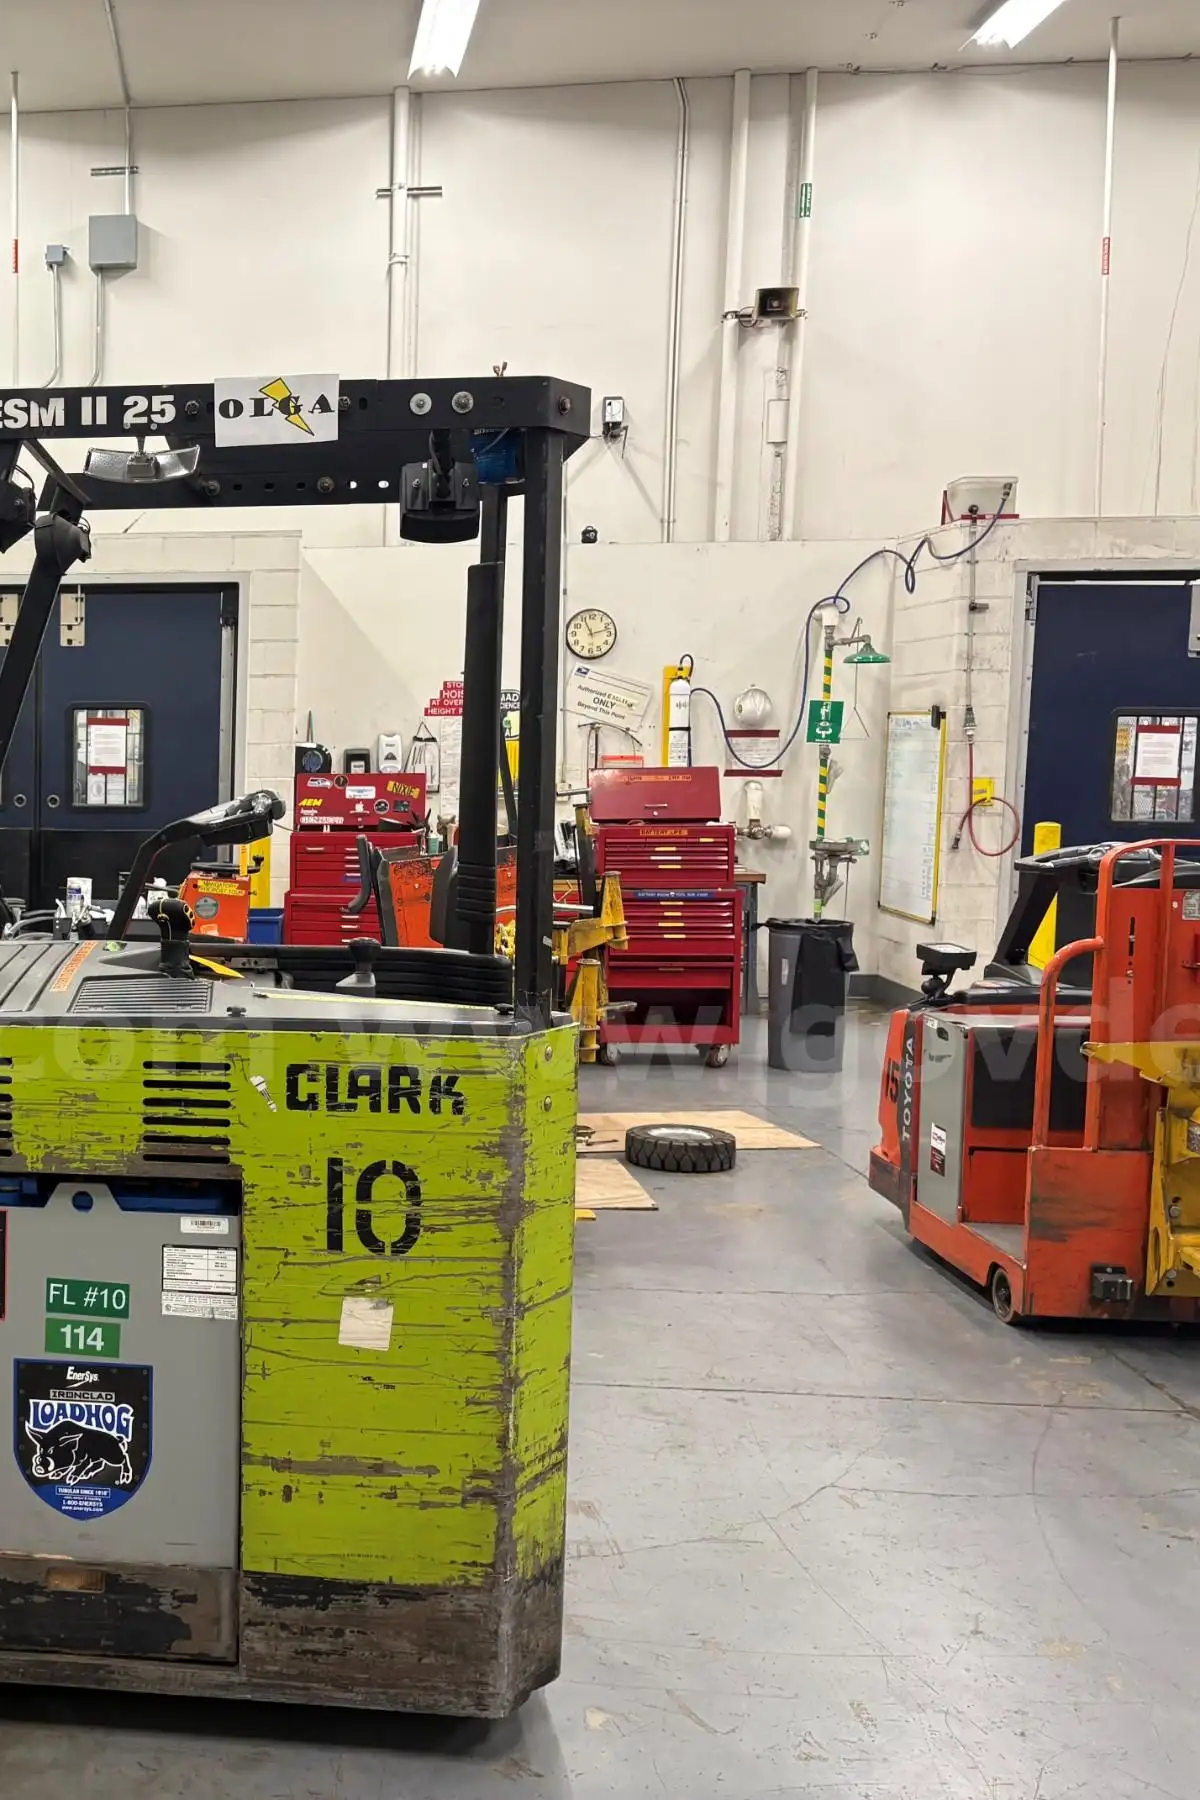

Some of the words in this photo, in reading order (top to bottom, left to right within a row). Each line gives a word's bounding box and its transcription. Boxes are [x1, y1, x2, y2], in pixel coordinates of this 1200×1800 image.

[81, 396, 107, 426] II
[123, 394, 176, 424] 25
[218, 393, 335, 419] OLGA
[577, 701, 598, 712] Beyond
[593, 697, 616, 709] ONLY
[286, 1064, 465, 1115] CLARK
[902, 1036, 914, 1142] TOYOTA
[326, 1157, 421, 1256] 10
[49, 1283, 76, 1305] FL
[84, 1288, 126, 1309] #10
[60, 1324, 105, 1351] 114
[66, 1366, 99, 1382] EnerSys
[51, 1390, 113, 1400] IRONCLAD
[29, 1399, 134, 1442] LOADHOG
